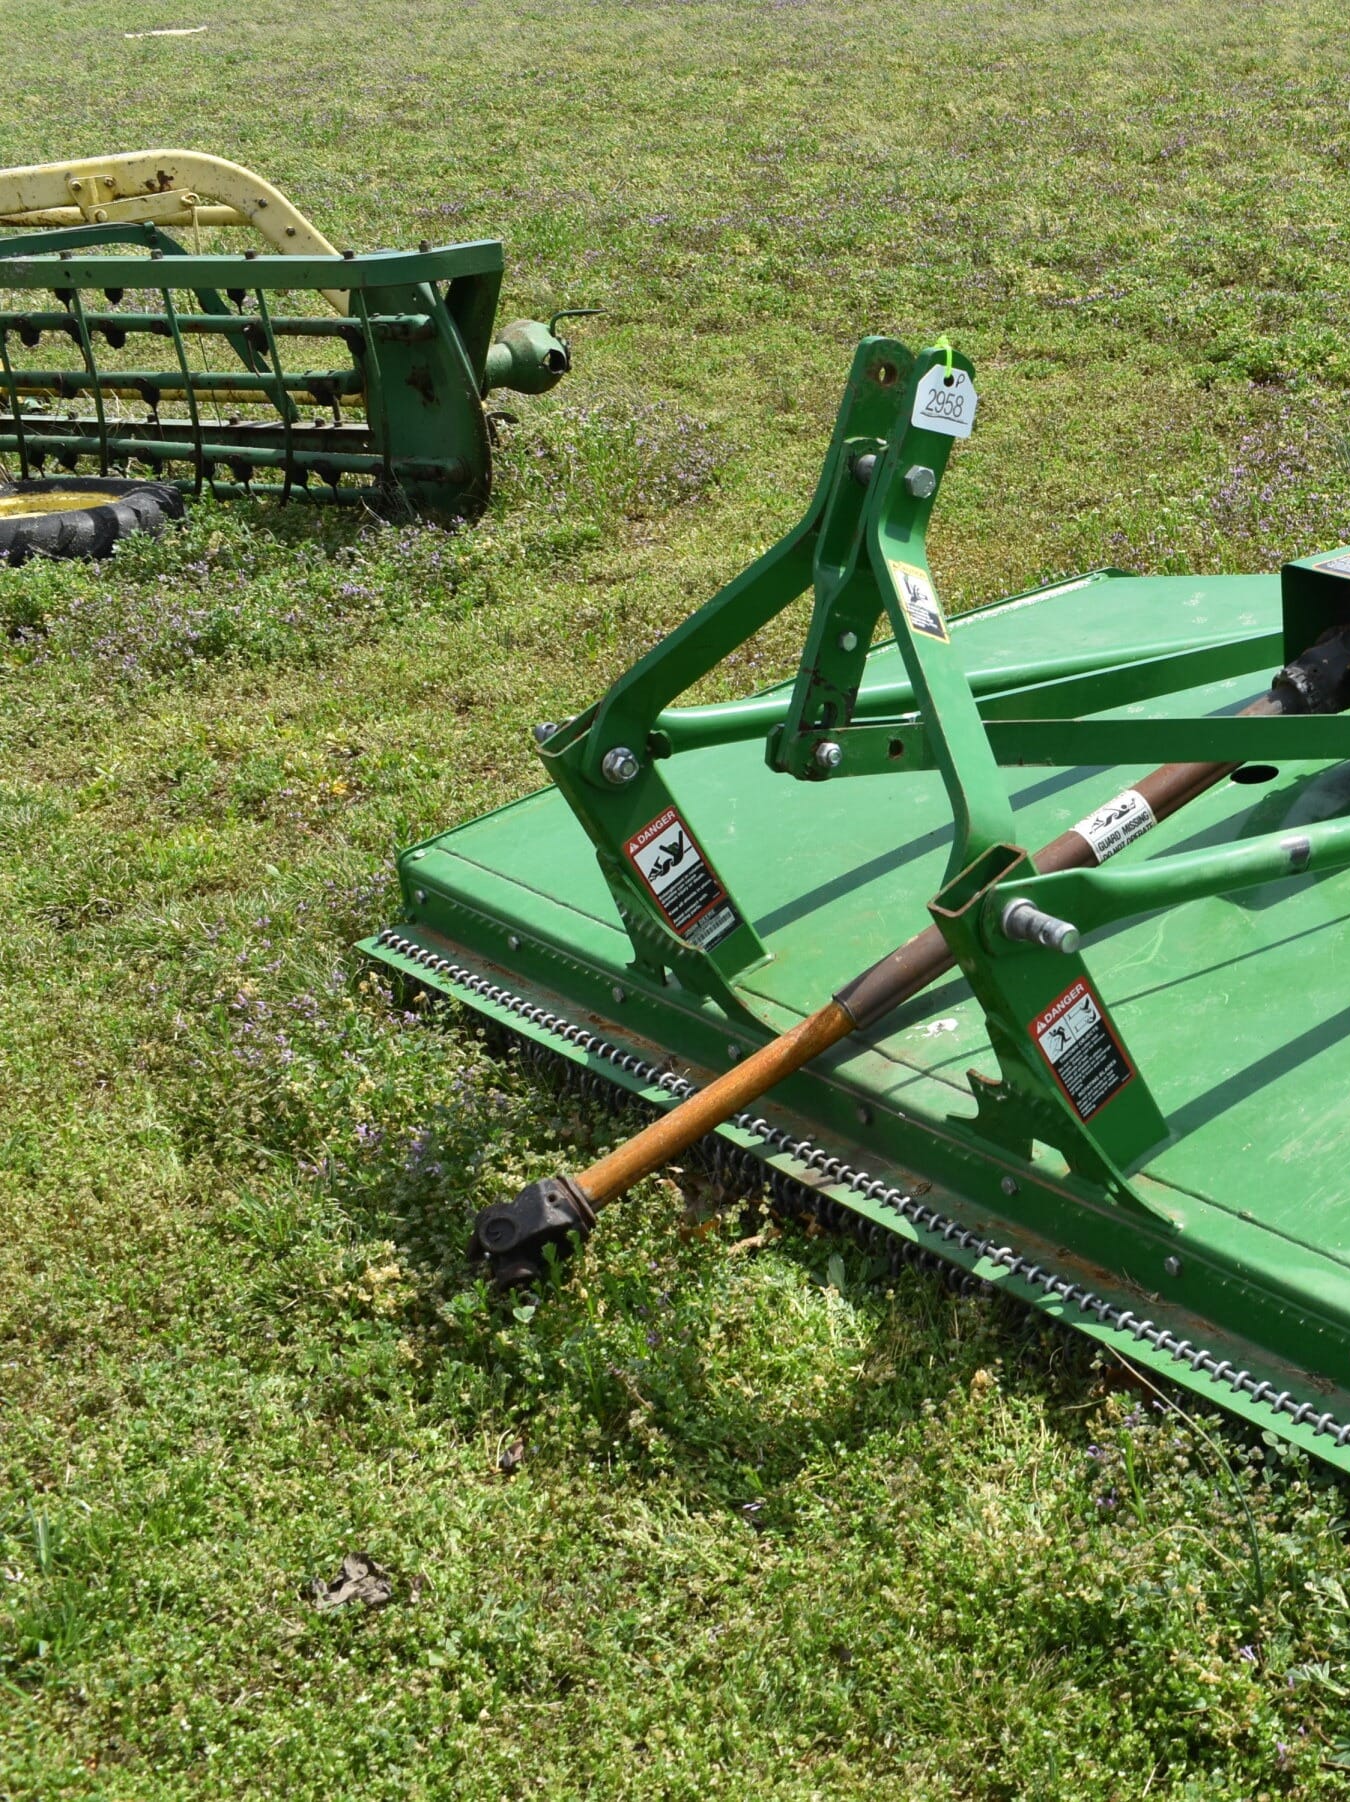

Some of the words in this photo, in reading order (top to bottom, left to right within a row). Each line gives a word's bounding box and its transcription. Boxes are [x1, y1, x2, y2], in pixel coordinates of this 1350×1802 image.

[925, 388, 964, 418] 2958
[637, 810, 676, 845] DANGER
[1097, 831, 1121, 852] GUARD
[1121, 811, 1149, 836] MISSING
[1044, 983, 1085, 1024] DANGER
